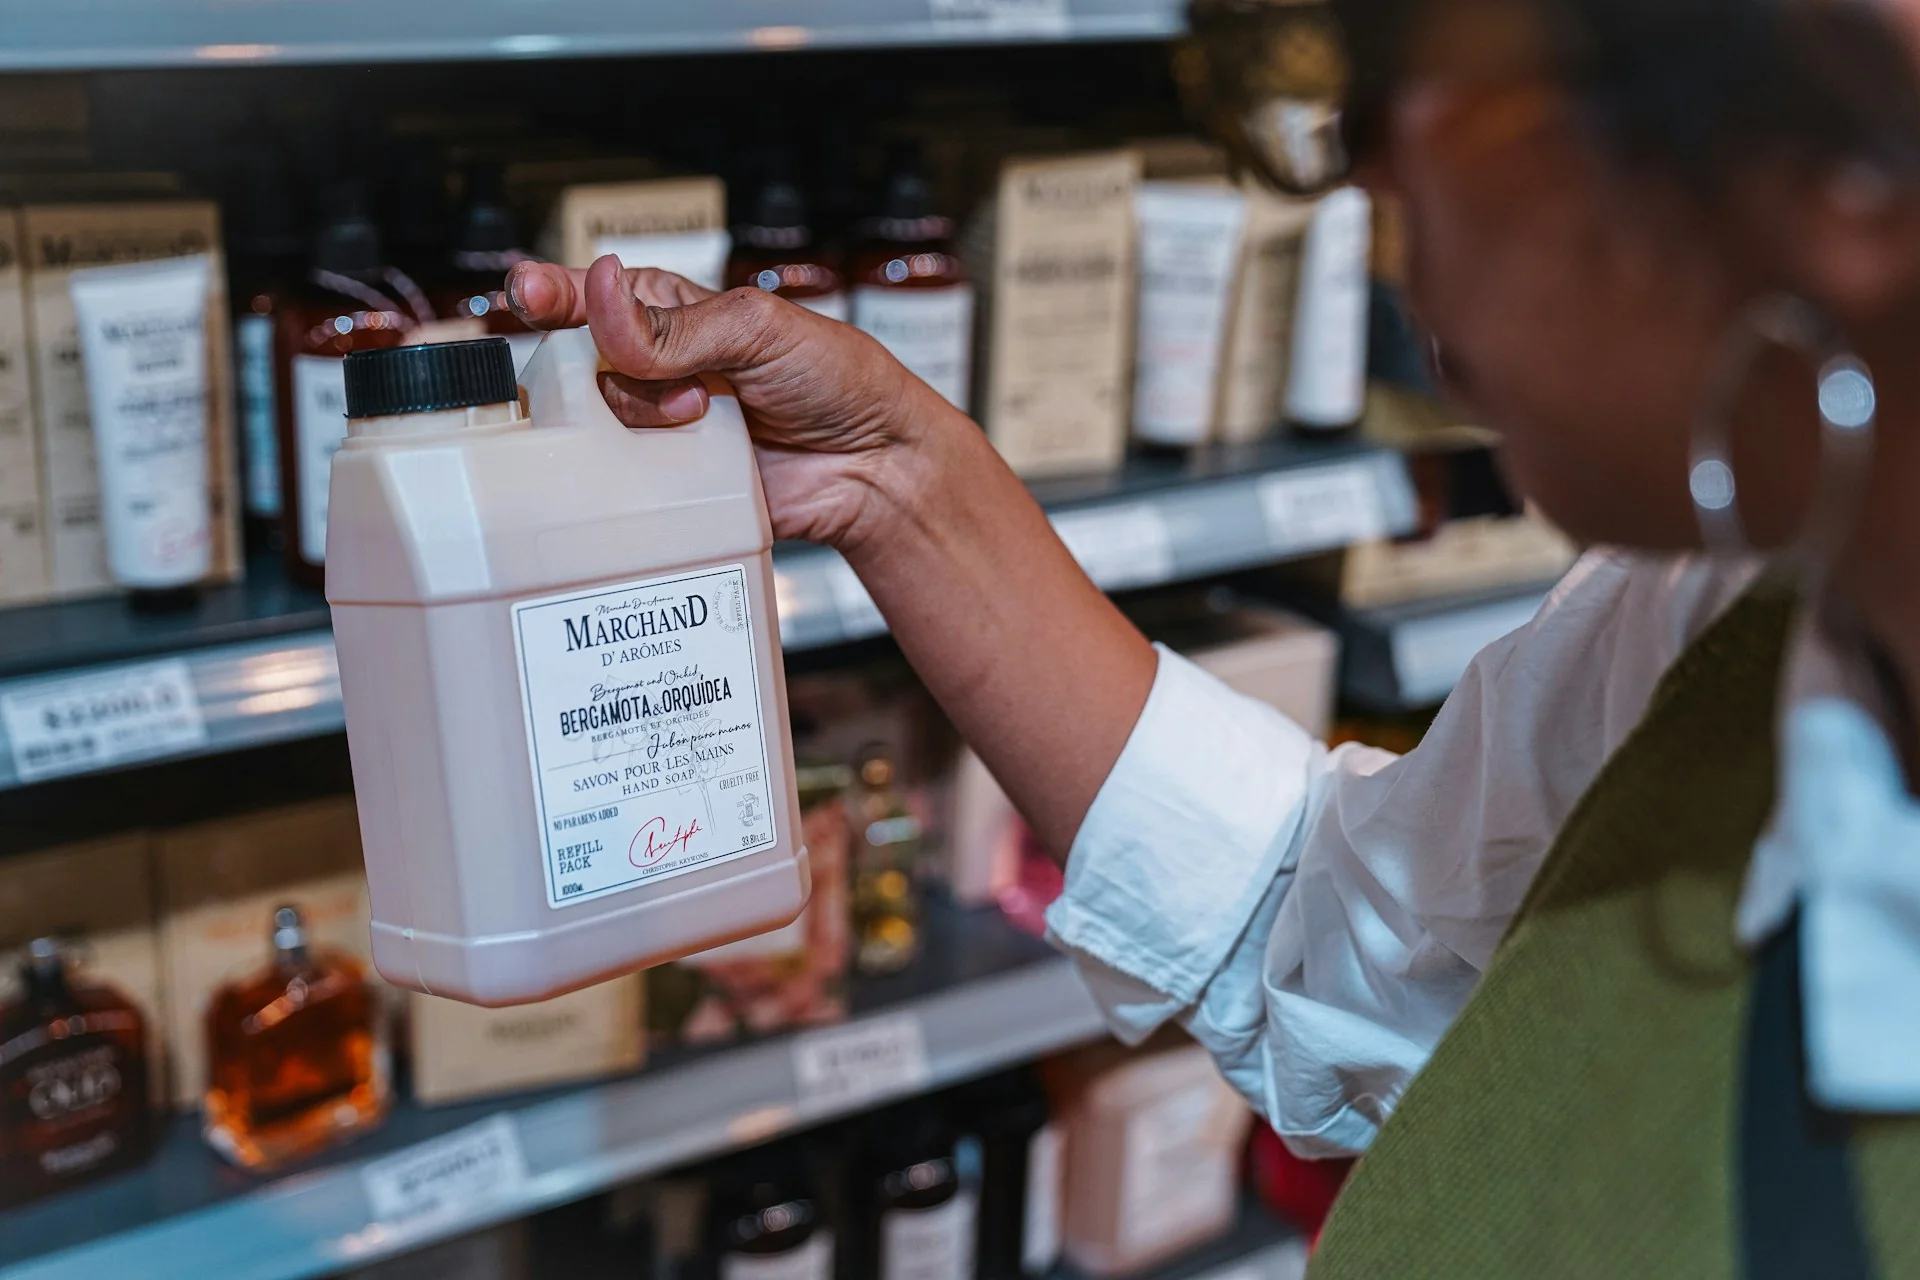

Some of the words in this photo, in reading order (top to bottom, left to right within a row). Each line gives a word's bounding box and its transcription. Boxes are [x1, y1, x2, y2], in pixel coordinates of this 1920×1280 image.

[563, 594, 708, 652] MARCHAND
[646, 671, 663, 686] and
[664, 664, 699, 686] Orchid
[591, 724, 647, 743] BERGAMOTE
[650, 720, 662, 730] ET
[717, 722, 753, 737] manos
[573, 770, 619, 792] SAVON
[625, 761, 661, 780] POUR
[666, 754, 690, 770] LES
[695, 743, 735, 763] MAINS
[622, 777, 660, 796] HAND
[665, 768, 696, 785] SOAP
[719, 774, 744, 790] CRUELTY
[745, 771, 760, 784] FREE
[553, 820, 563, 831] NO
[563, 811, 597, 830] PARABENS
[598, 806, 619, 821] ADDED
[557, 839, 603, 861] REFILL
[559, 855, 592, 875] PACK
[642, 860, 678, 875] CHRISTOPHE
